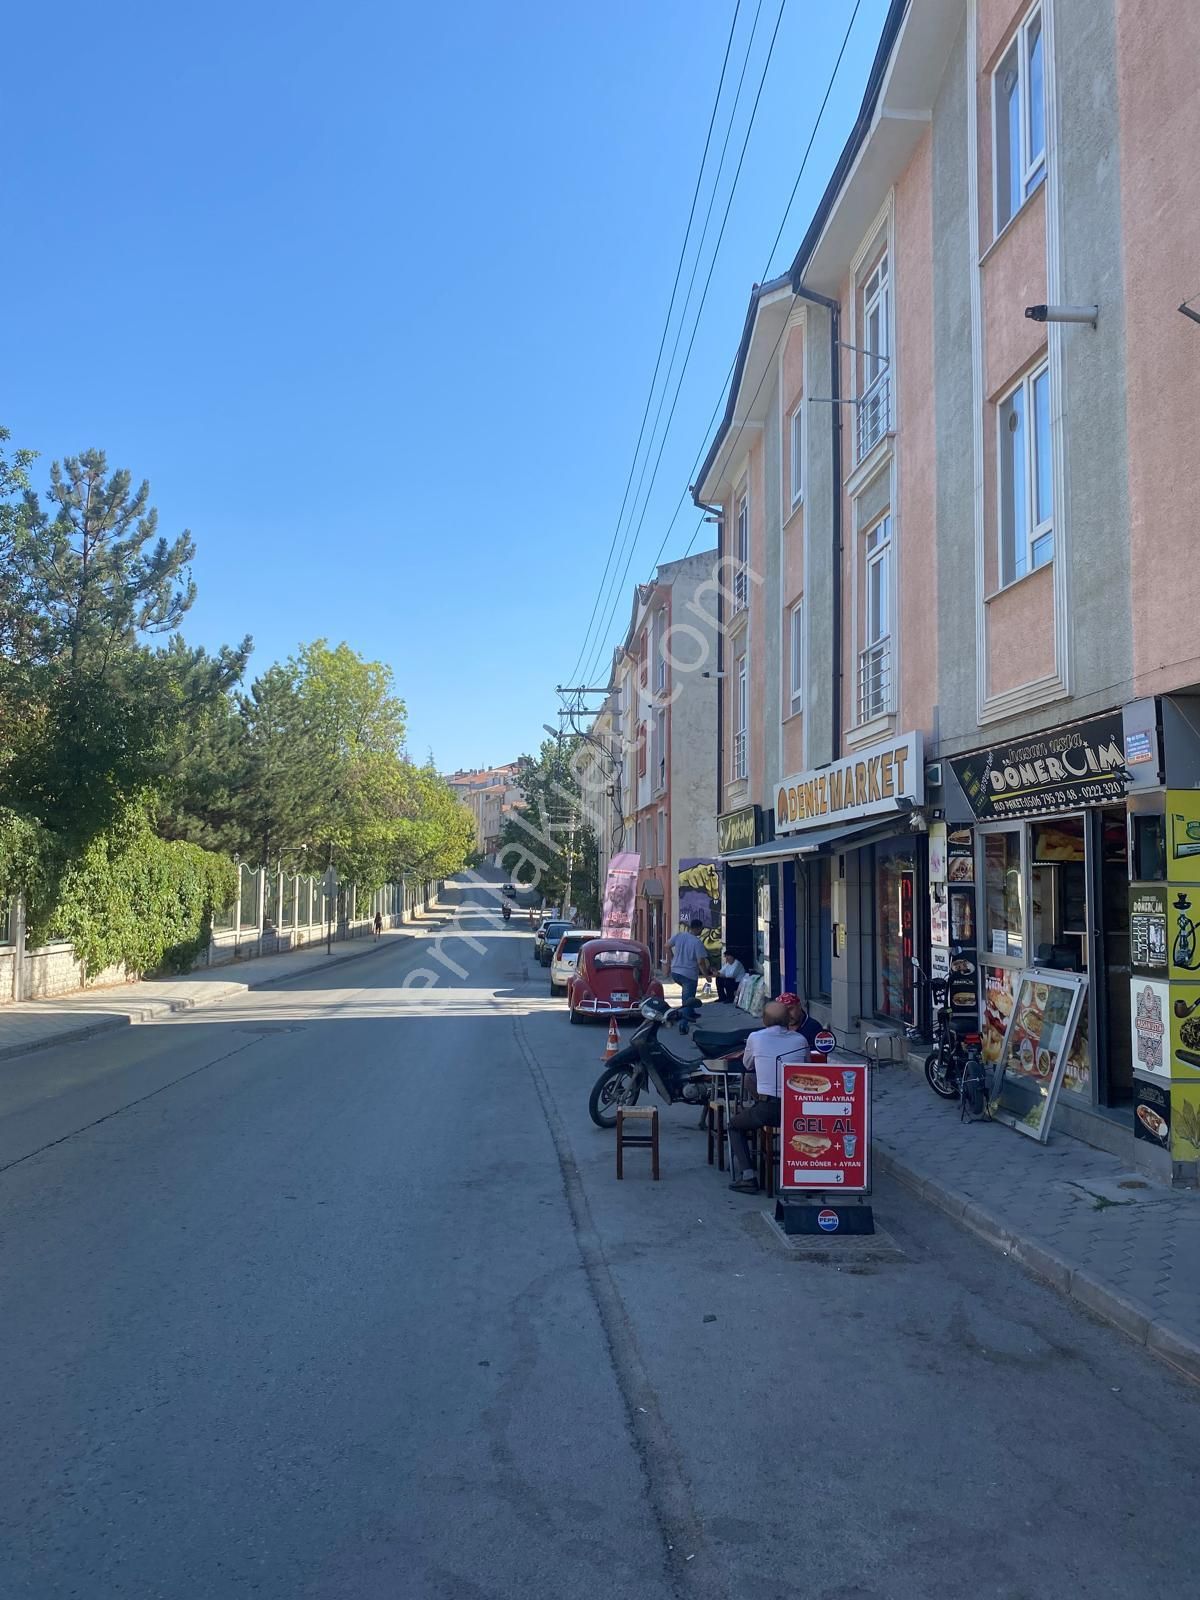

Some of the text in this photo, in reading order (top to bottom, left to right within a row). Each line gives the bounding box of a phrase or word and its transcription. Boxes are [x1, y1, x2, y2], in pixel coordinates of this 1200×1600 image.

[1049, 732, 1083, 753] usta
[829, 745, 909, 813] MARKET
[1041, 792, 1055, 805] 795
[1055, 790, 1066, 803] 29
[1066, 788, 1078, 801] 48
[1081, 785, 1103, 798] 0222
[1103, 781, 1121, 795] 320
[815, 1038, 834, 1046] PEPSI
[794, 1094, 824, 1103] TANTUNİ
[832, 1095, 855, 1103] AYRAN
[793, 1118, 855, 1133] GEL AL
[809, 1159, 832, 1167] DÖNER
